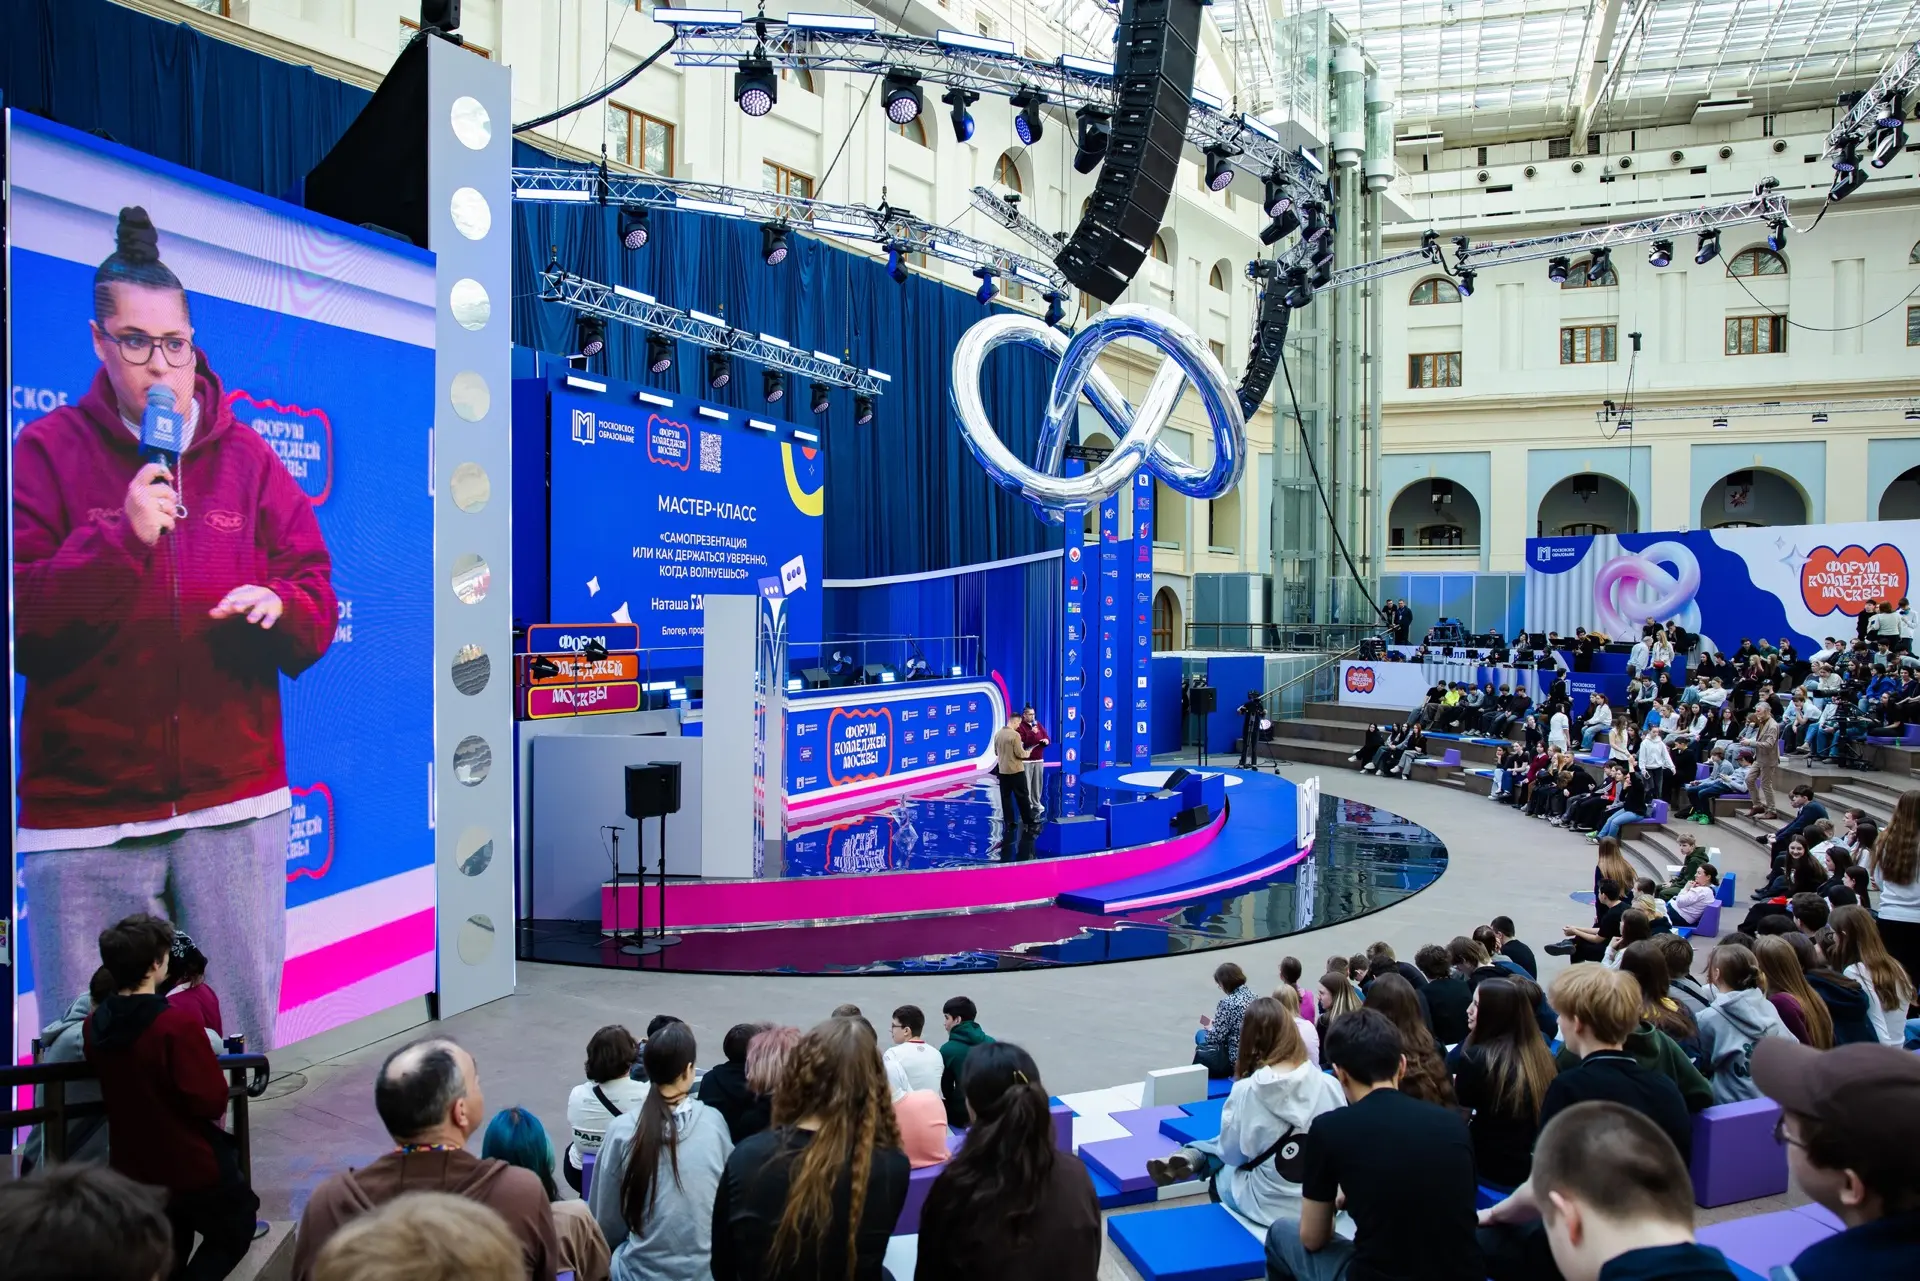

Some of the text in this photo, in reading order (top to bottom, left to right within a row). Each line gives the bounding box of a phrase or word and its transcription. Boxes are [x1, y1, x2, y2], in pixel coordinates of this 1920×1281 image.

[598, 420, 635, 434] МОСКОВСКОЕ
[659, 428, 680, 439] ФОРУМ
[598, 430, 635, 444] ОБРАЗОВАНИЕ
[651, 435, 687, 449] КОЛЛЕДЖЕЙ
[657, 445, 681, 457] МОСКВЫ
[658, 494, 757, 522] МАСТЕР-КЛАСС
[660, 531, 747, 550] «САМОПРЕЗЕНТАЦИЯ
[632, 546, 768, 567] ИЛИ КАК ДЕРЖАТЬСЯ УВЕРЕННО,
[659, 565, 749, 580] КОГДА ВОЛНУЕШЬСЯ»
[1825, 561, 1880, 574] ФОРУМ
[1808, 572, 1899, 590] КОЛЛЕДЖЕЙ
[1821, 585, 1885, 602] МОСКВЫ
[651, 594, 705, 610] Наташа ГА
[662, 626, 688, 637] Блогер,
[552, 686, 608, 707] МОСКВЫ
[845, 722, 877, 738] ФОРУМ
[834, 733, 887, 756] КОЛЛЕДЖЕЙ
[843, 751, 879, 769] МОСКВЫ
[1286, 1146, 1295, 1155] 8
